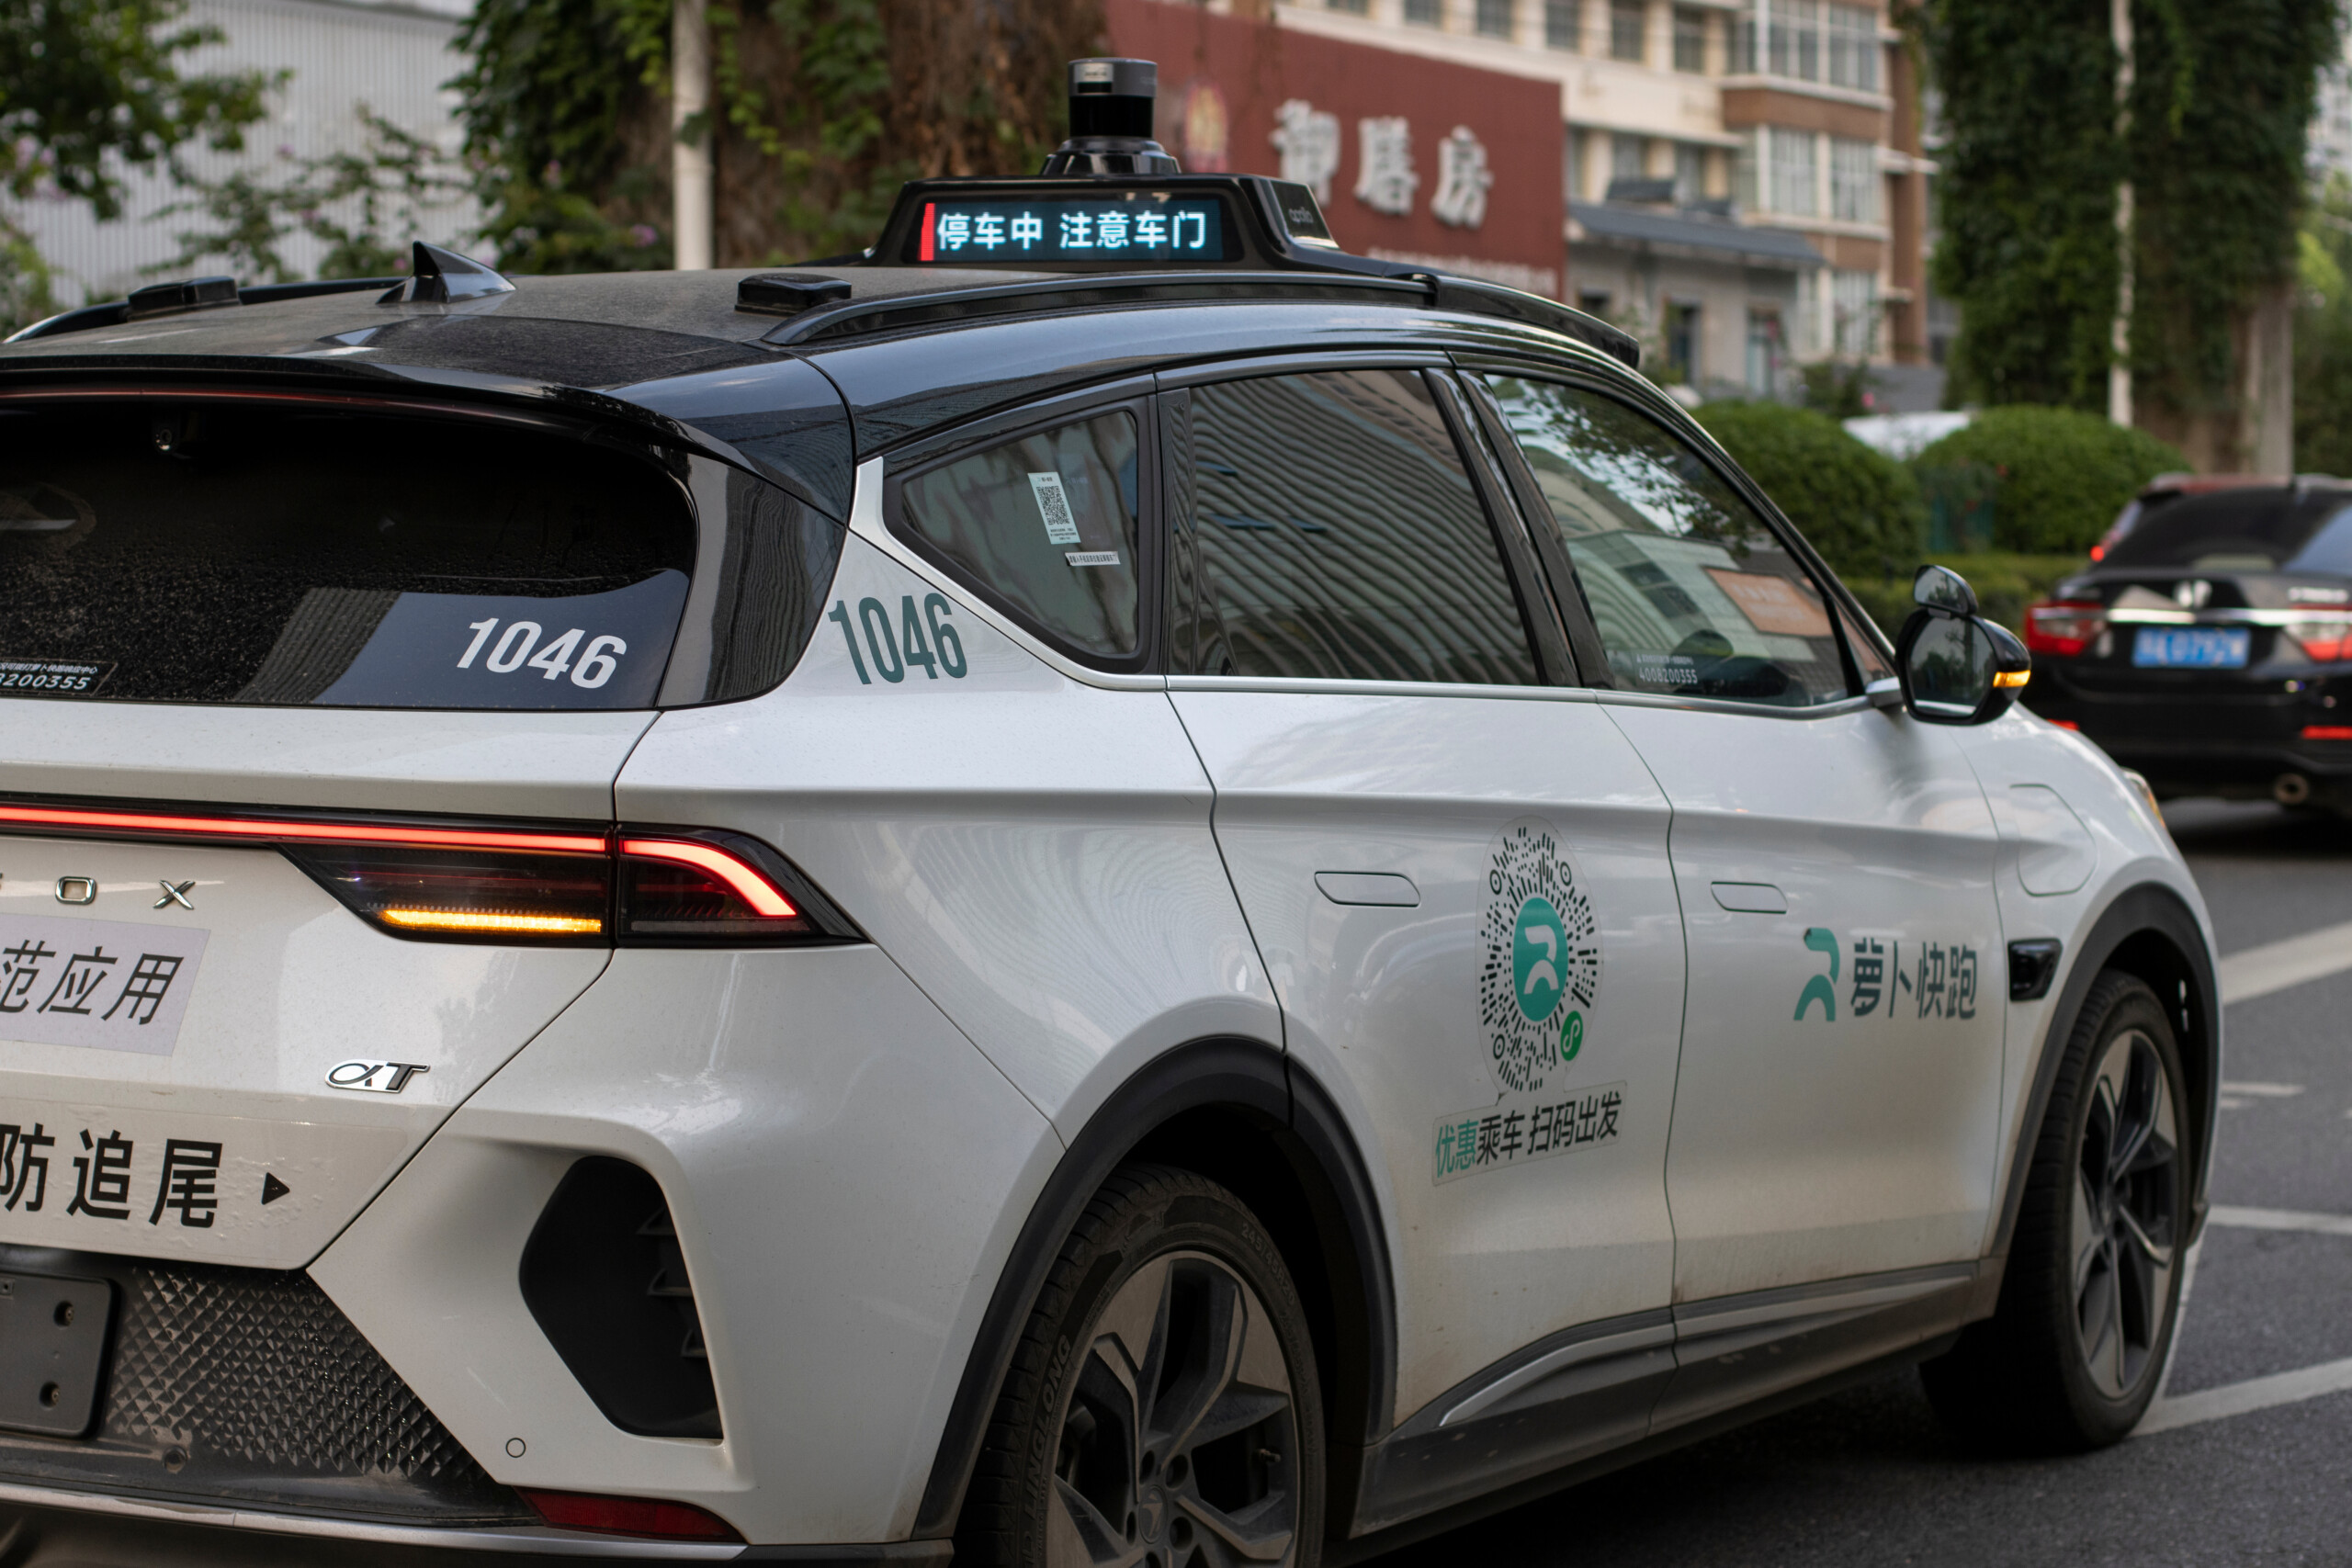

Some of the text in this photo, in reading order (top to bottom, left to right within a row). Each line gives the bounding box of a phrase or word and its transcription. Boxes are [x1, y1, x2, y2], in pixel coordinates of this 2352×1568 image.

[937, 210, 1206, 251] 停车中 注意车门
[457, 617, 628, 689] 1046
[828, 592, 968, 685] 1046
[1639, 667, 1699, 684] 4008200355
[1850, 936, 1977, 1021] 萝卜快跑
[0, 1122, 223, 1228] 防追尾
[1435, 1090, 1622, 1178] 优惠乘车 扫码出发
[1023, 1334, 1071, 1520] LINGLONG
